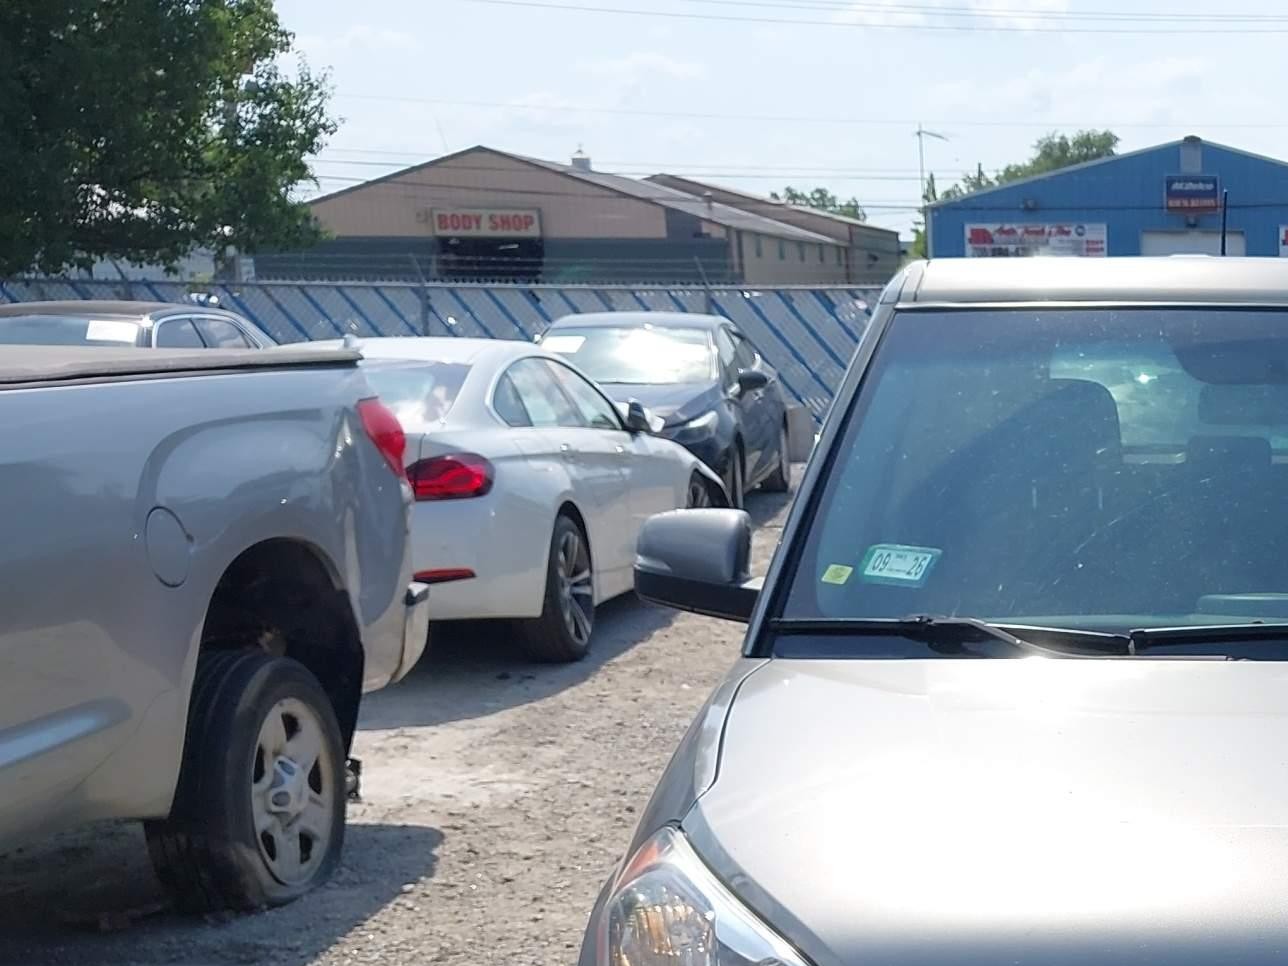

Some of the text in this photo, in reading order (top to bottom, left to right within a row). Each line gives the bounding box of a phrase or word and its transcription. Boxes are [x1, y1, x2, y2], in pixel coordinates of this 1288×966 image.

[437, 213, 534, 231] BODY SHOP
[872, 552, 892, 572] 09
